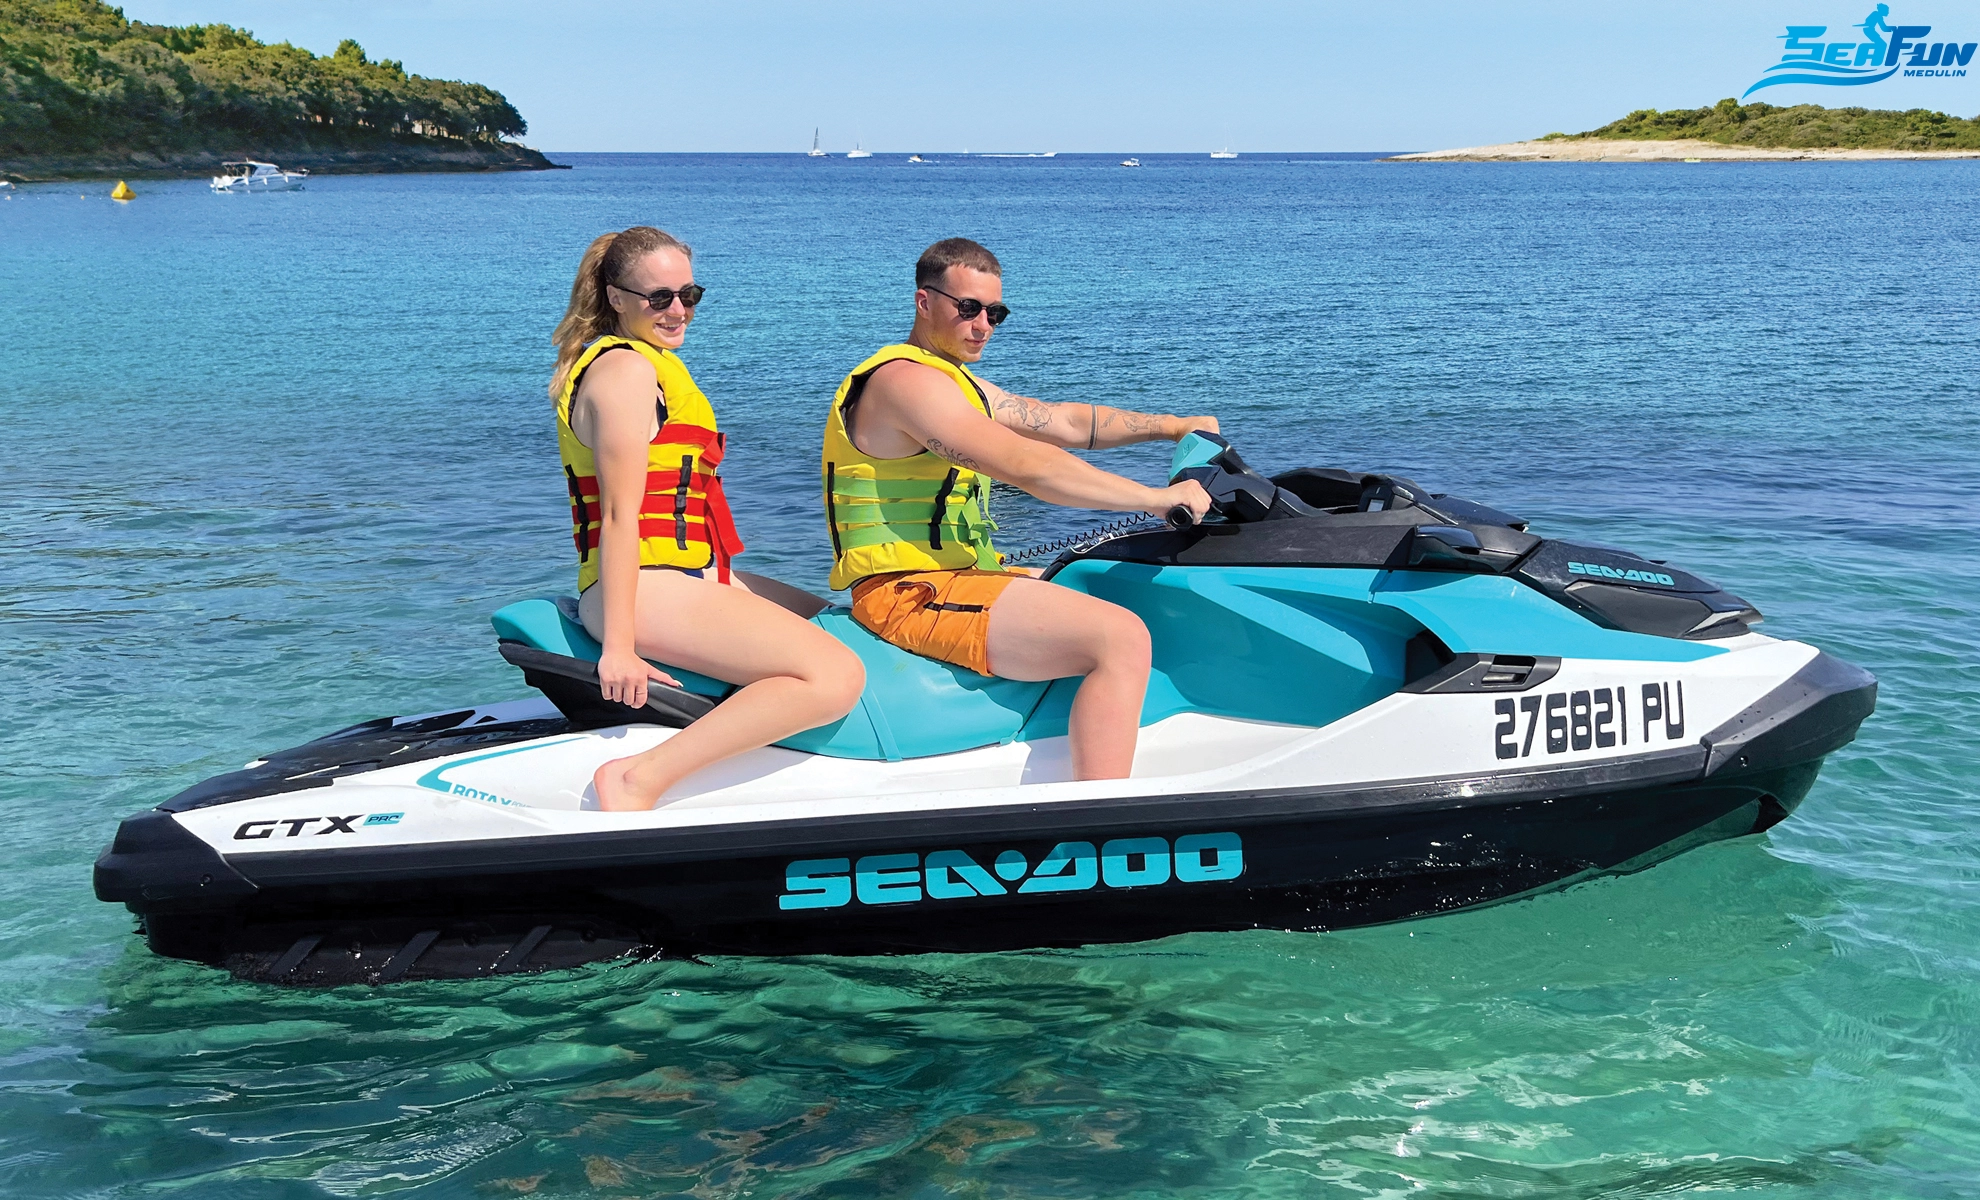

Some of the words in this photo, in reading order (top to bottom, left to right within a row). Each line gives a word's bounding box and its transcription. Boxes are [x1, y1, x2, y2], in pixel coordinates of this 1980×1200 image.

[1494, 686, 1628, 760] 276821
[1641, 680, 1685, 743] PU
[232, 813, 366, 840] GTX
